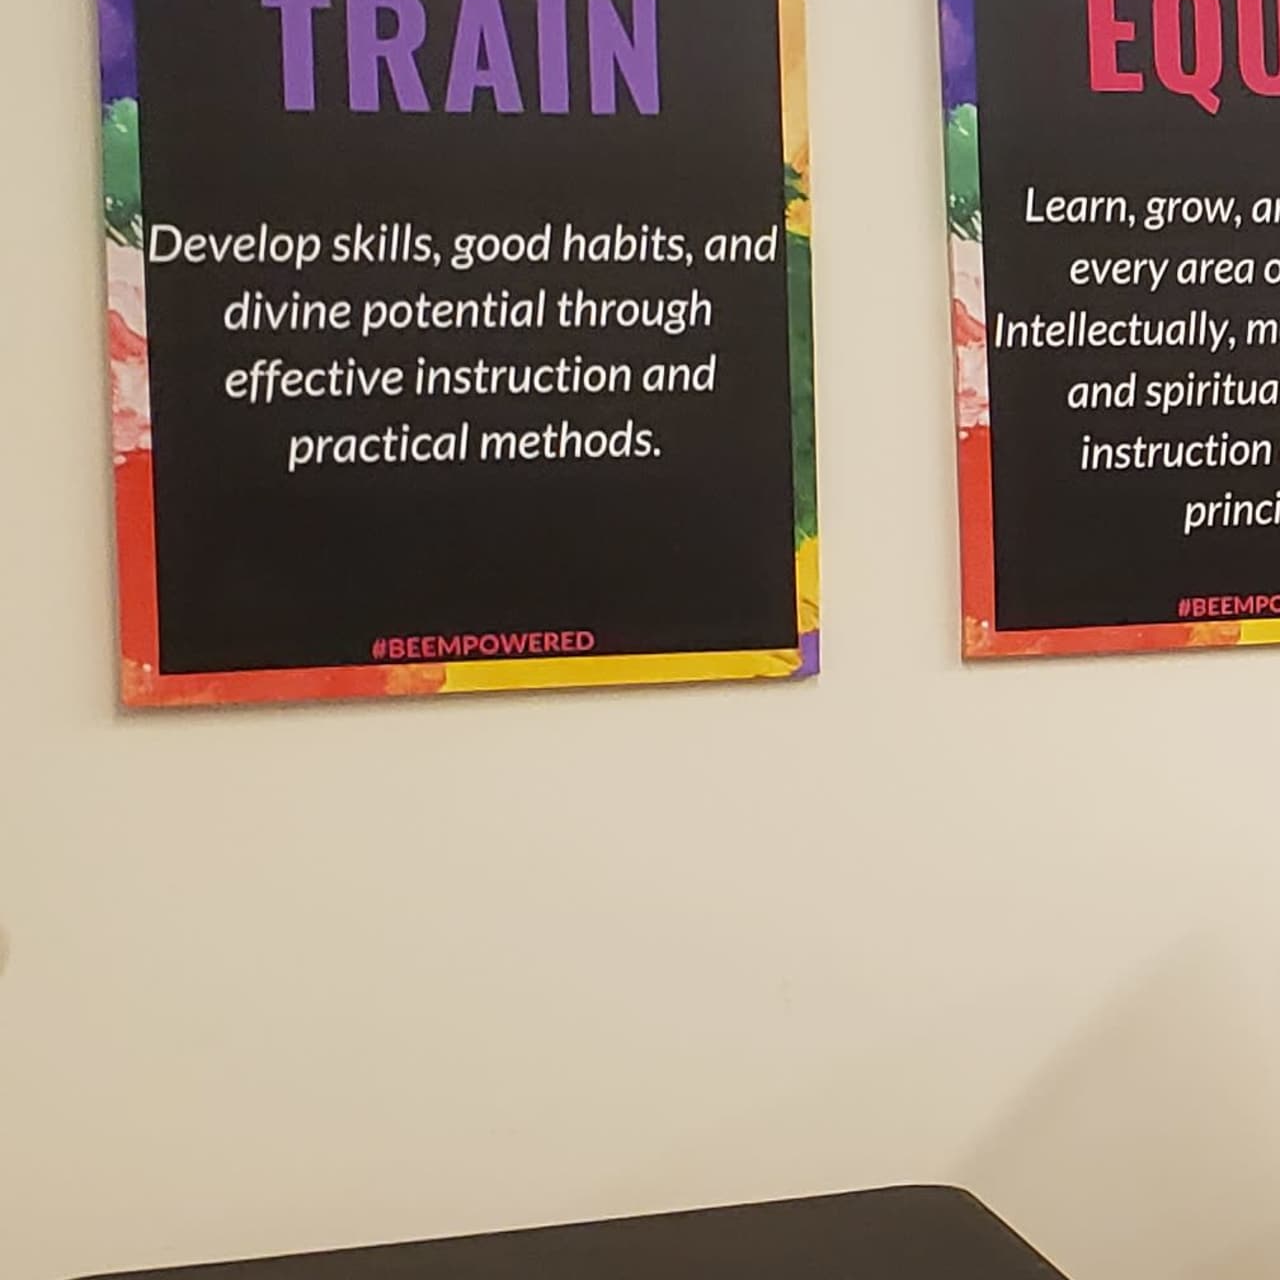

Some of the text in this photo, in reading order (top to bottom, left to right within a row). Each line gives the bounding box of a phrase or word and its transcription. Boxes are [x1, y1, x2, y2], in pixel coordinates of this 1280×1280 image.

[1026, 188, 1135, 227] Learn,
[1144, 197, 1241, 230] grow,
[149, 223, 777, 269] Develop skills, good habits, and
[1070, 259, 1168, 291] every
[1177, 259, 1254, 284] area
[224, 289, 711, 336] divine potential through
[996, 310, 1235, 352] Intellectually,
[226, 354, 716, 403] effective instruction and
[1068, 372, 1136, 408] and
[289, 420, 660, 472] practical methods.
[1082, 432, 1271, 469] instruction
[372, 631, 594, 659] #BEEMPOWERED
